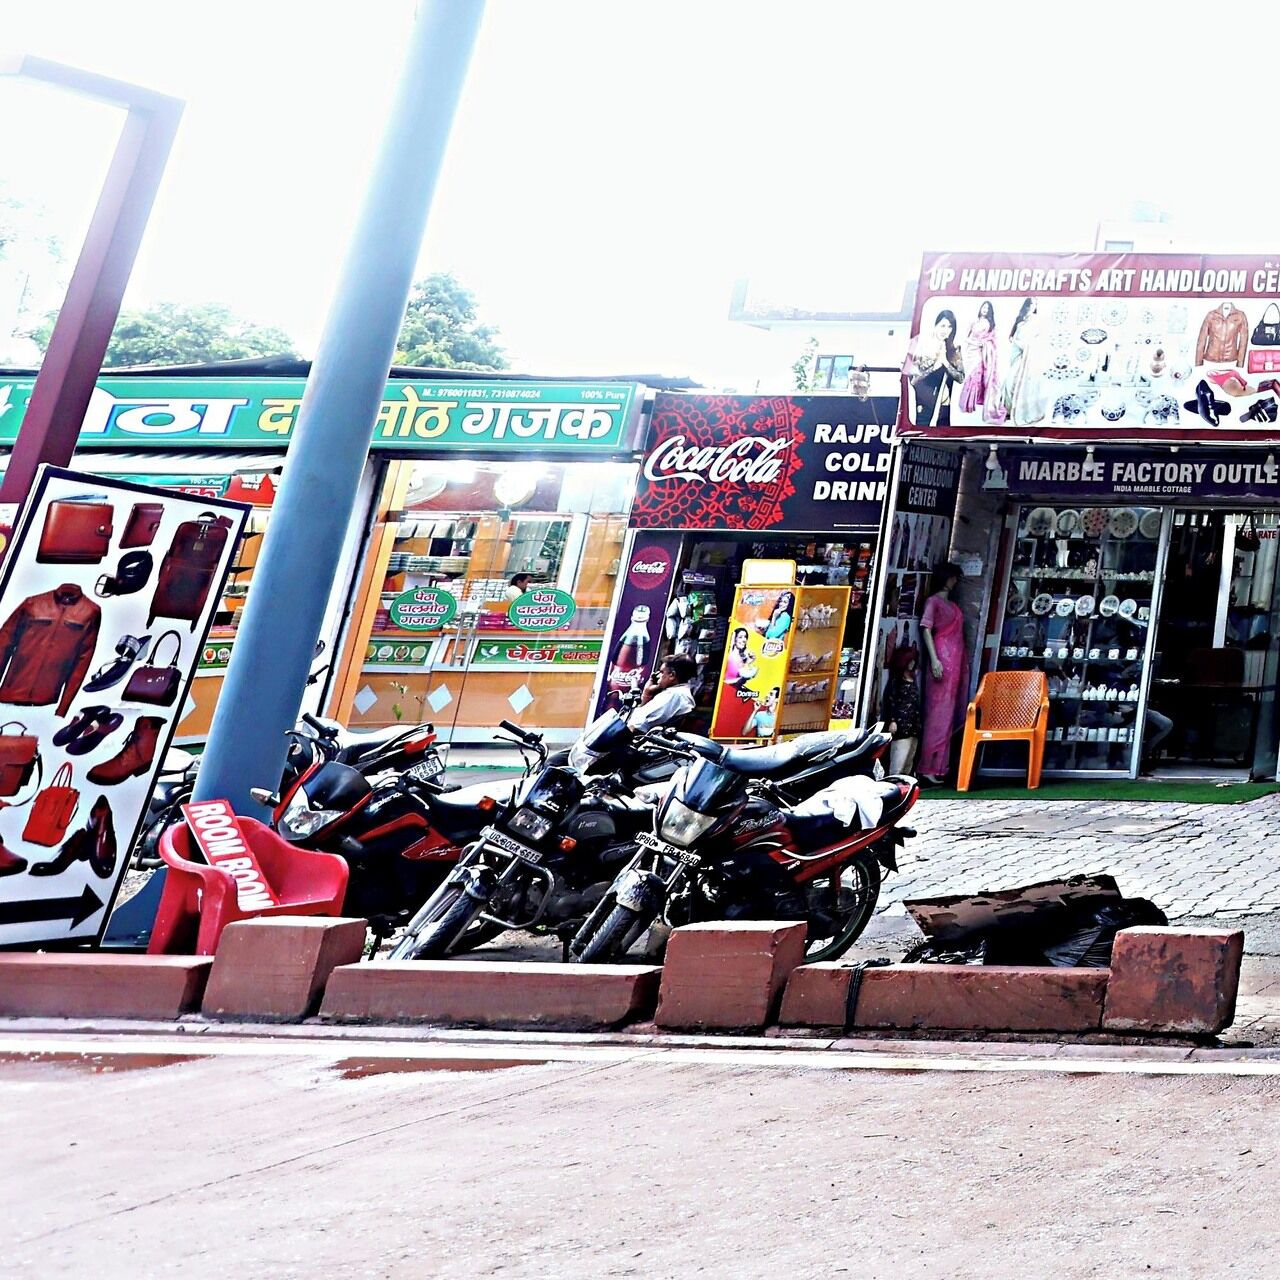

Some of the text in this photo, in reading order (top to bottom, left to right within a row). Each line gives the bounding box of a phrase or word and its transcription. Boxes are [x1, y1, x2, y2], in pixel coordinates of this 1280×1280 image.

[928, 268, 956, 291] UP
[959, 268, 1091, 292] HANDICRAFTS
[1097, 269, 1135, 292] ART
[1139, 269, 1246, 292] HANDLOOM
[580, 390, 626, 399] 100% Pure
[460, 401, 622, 440] गजक
[644, 435, 796, 484] Coca-Cola
[824, 452, 891, 472] COLD
[913, 468, 955, 489] HANDLOOM
[1018, 461, 1105, 481] MARBLE
[1112, 462, 1207, 483] FACTORY
[1113, 484, 1192, 493] INDIA MARBLE COTTAGE
[908, 486, 938, 507] CENTER
[1258, 530, 1277, 539] RATE
[631, 560, 668, 574] Coca-Cola
[414, 591, 437, 602] पेठा
[532, 592, 555, 603] पेठा
[398, 602, 448, 614] दालमोठ
[516, 603, 567, 614] दालमोठ
[400, 615, 440, 625] गजक
[519, 616, 558, 626] गजक
[506, 643, 560, 662] पेठा
[188, 802, 247, 857] ROOM
